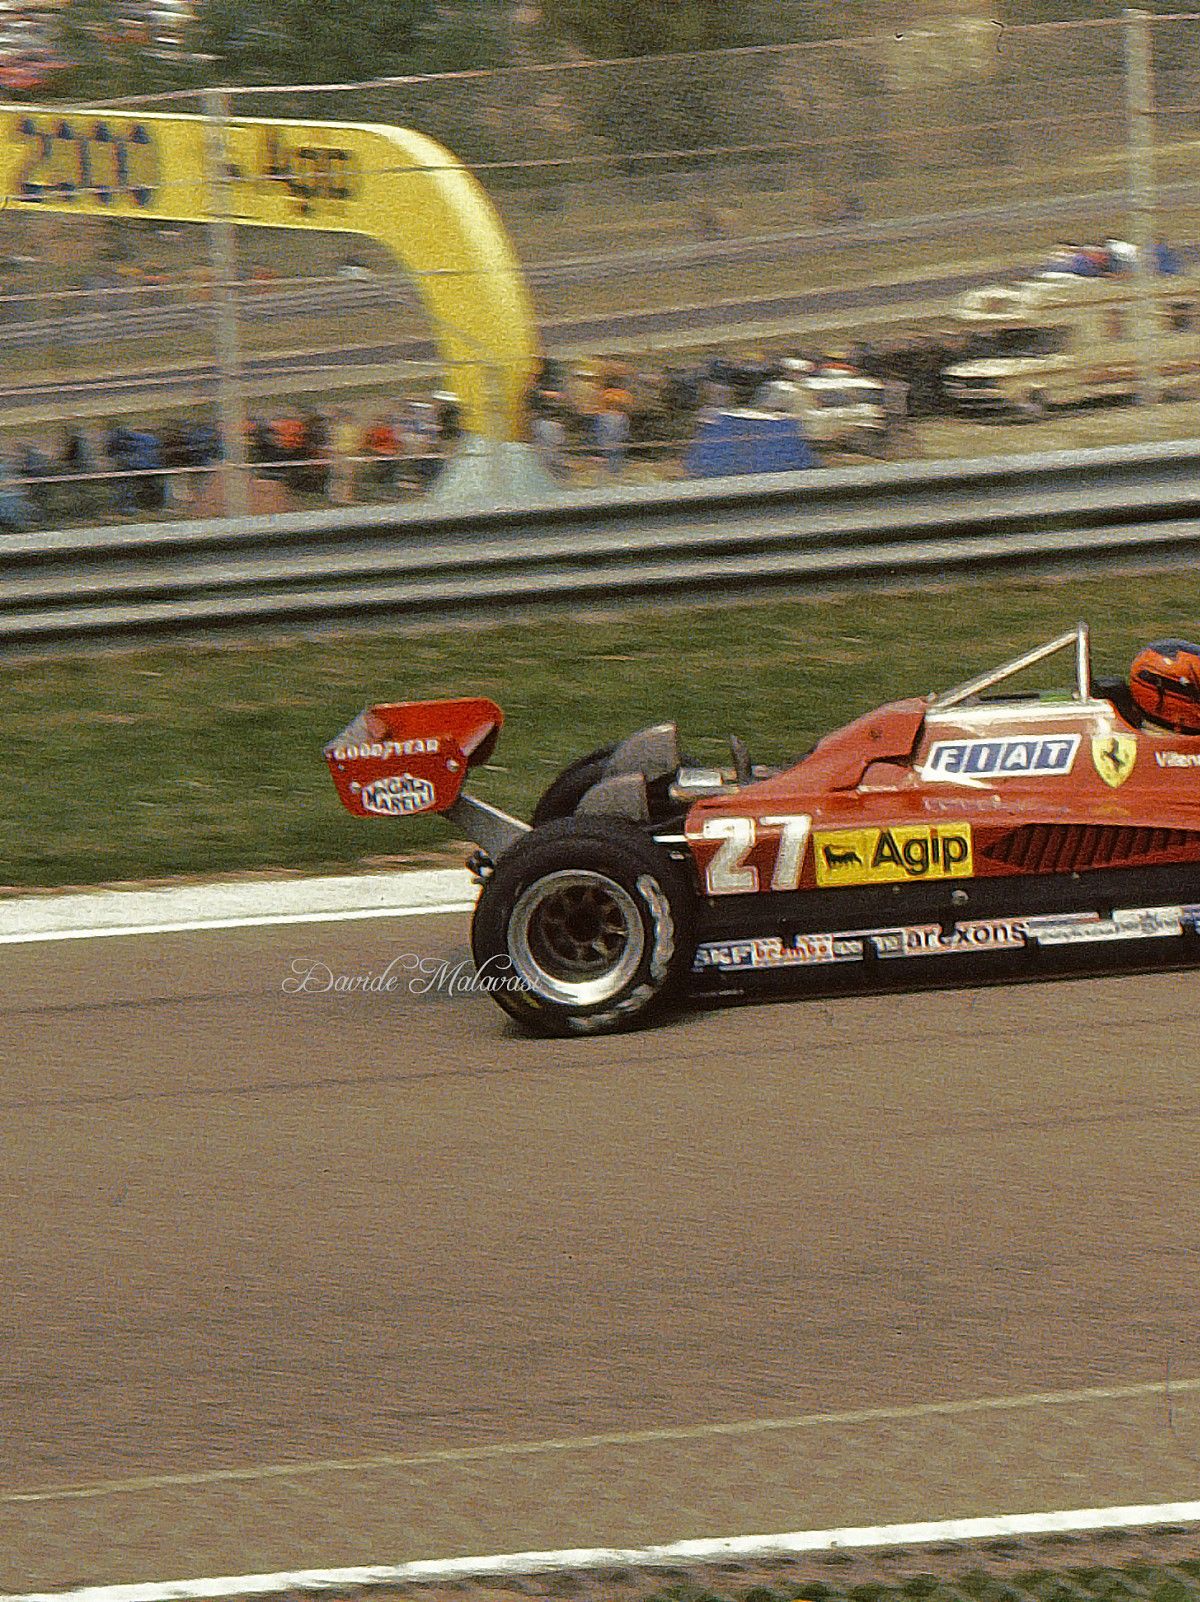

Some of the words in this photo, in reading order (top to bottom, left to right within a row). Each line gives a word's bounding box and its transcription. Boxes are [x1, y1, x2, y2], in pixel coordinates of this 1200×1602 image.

[333, 739, 440, 761] GOODYEAR
[932, 739, 1076, 774] FIAT
[702, 813, 812, 896] 27
[871, 832, 968, 875] Agip
[693, 946, 750, 966] SKF
